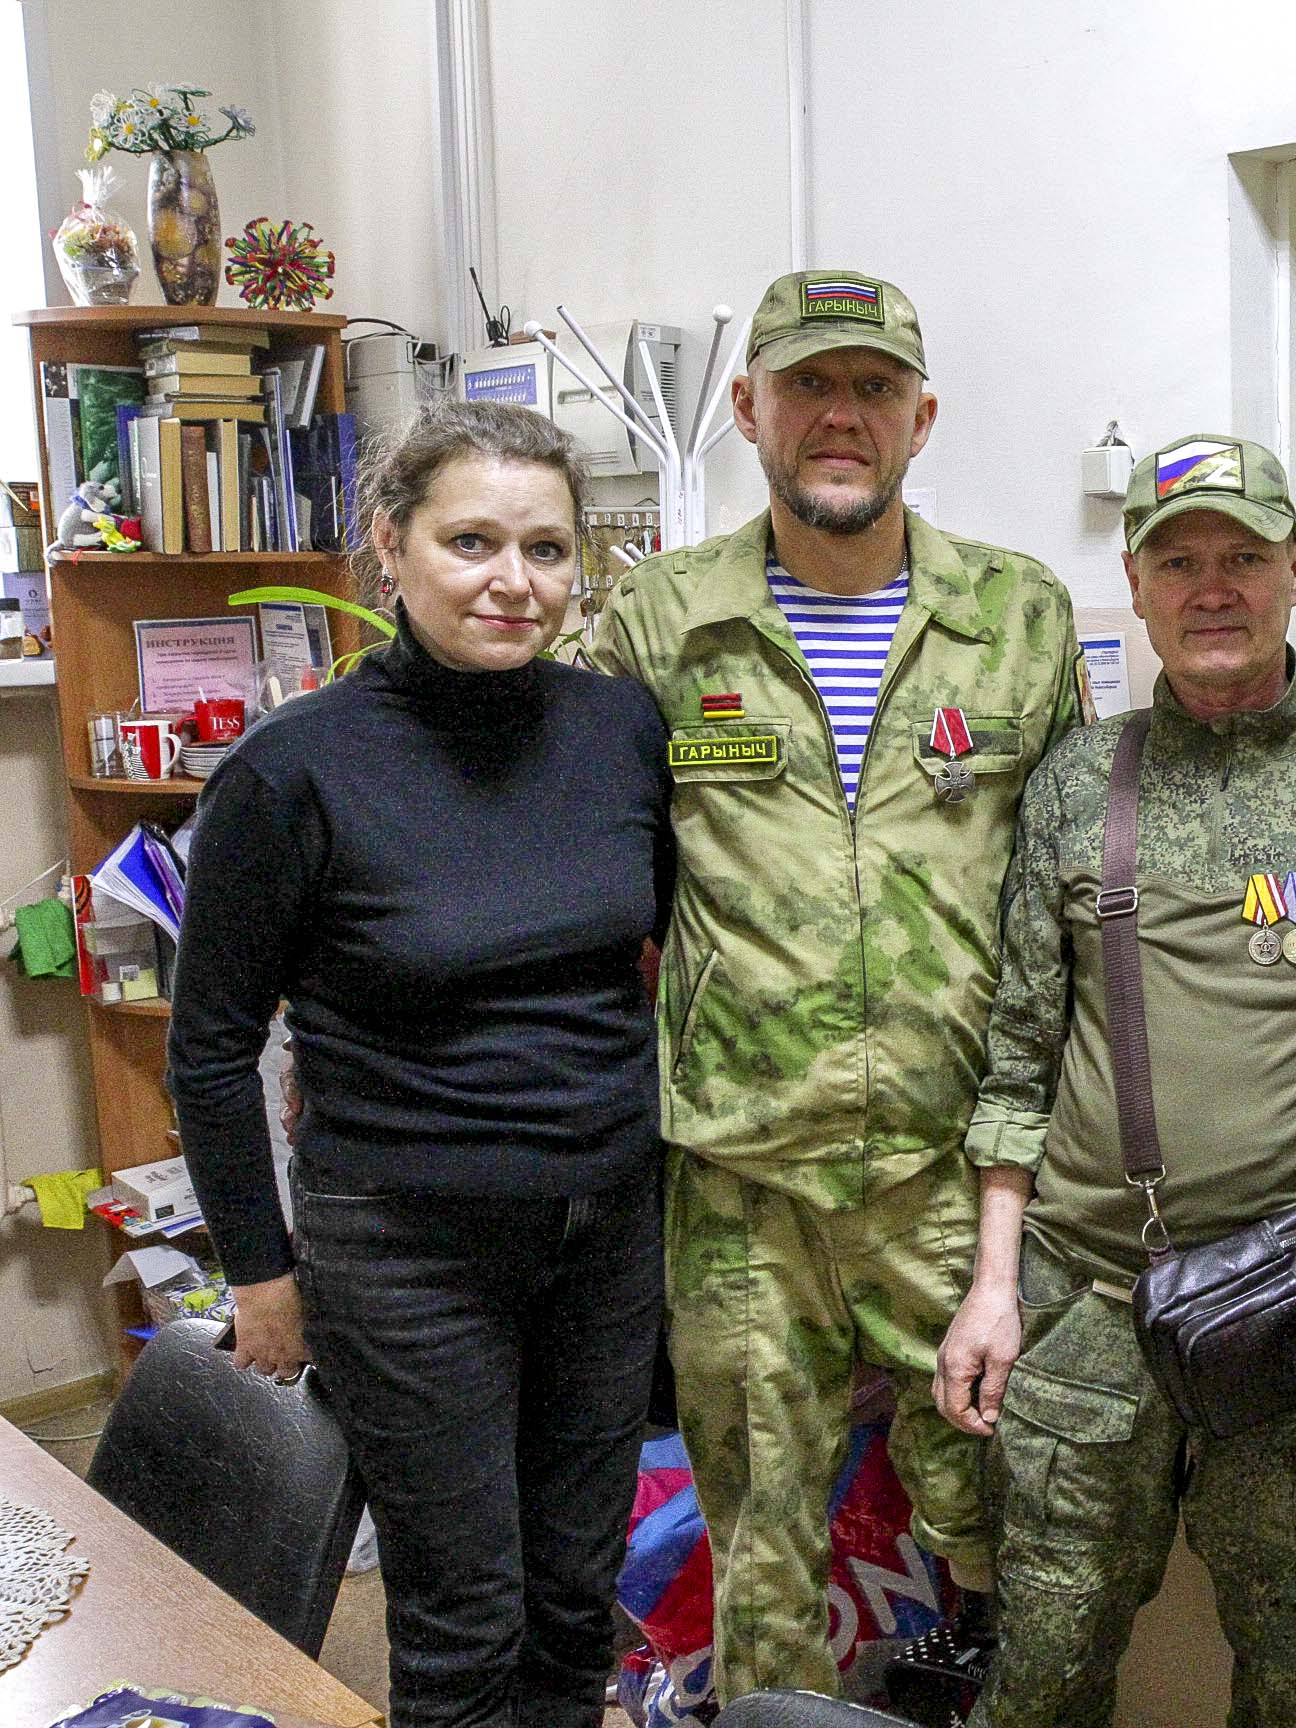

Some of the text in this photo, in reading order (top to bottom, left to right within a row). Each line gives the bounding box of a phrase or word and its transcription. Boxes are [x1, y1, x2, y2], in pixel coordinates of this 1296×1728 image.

[808, 299, 877, 317] ГАРЫНЫЧ
[1203, 456, 1239, 485] Z
[145, 637, 235, 649] ИНСТРУКЦИЯ
[209, 716, 240, 730] TESS
[680, 743, 766, 760] ГАРЫНЫЧ
